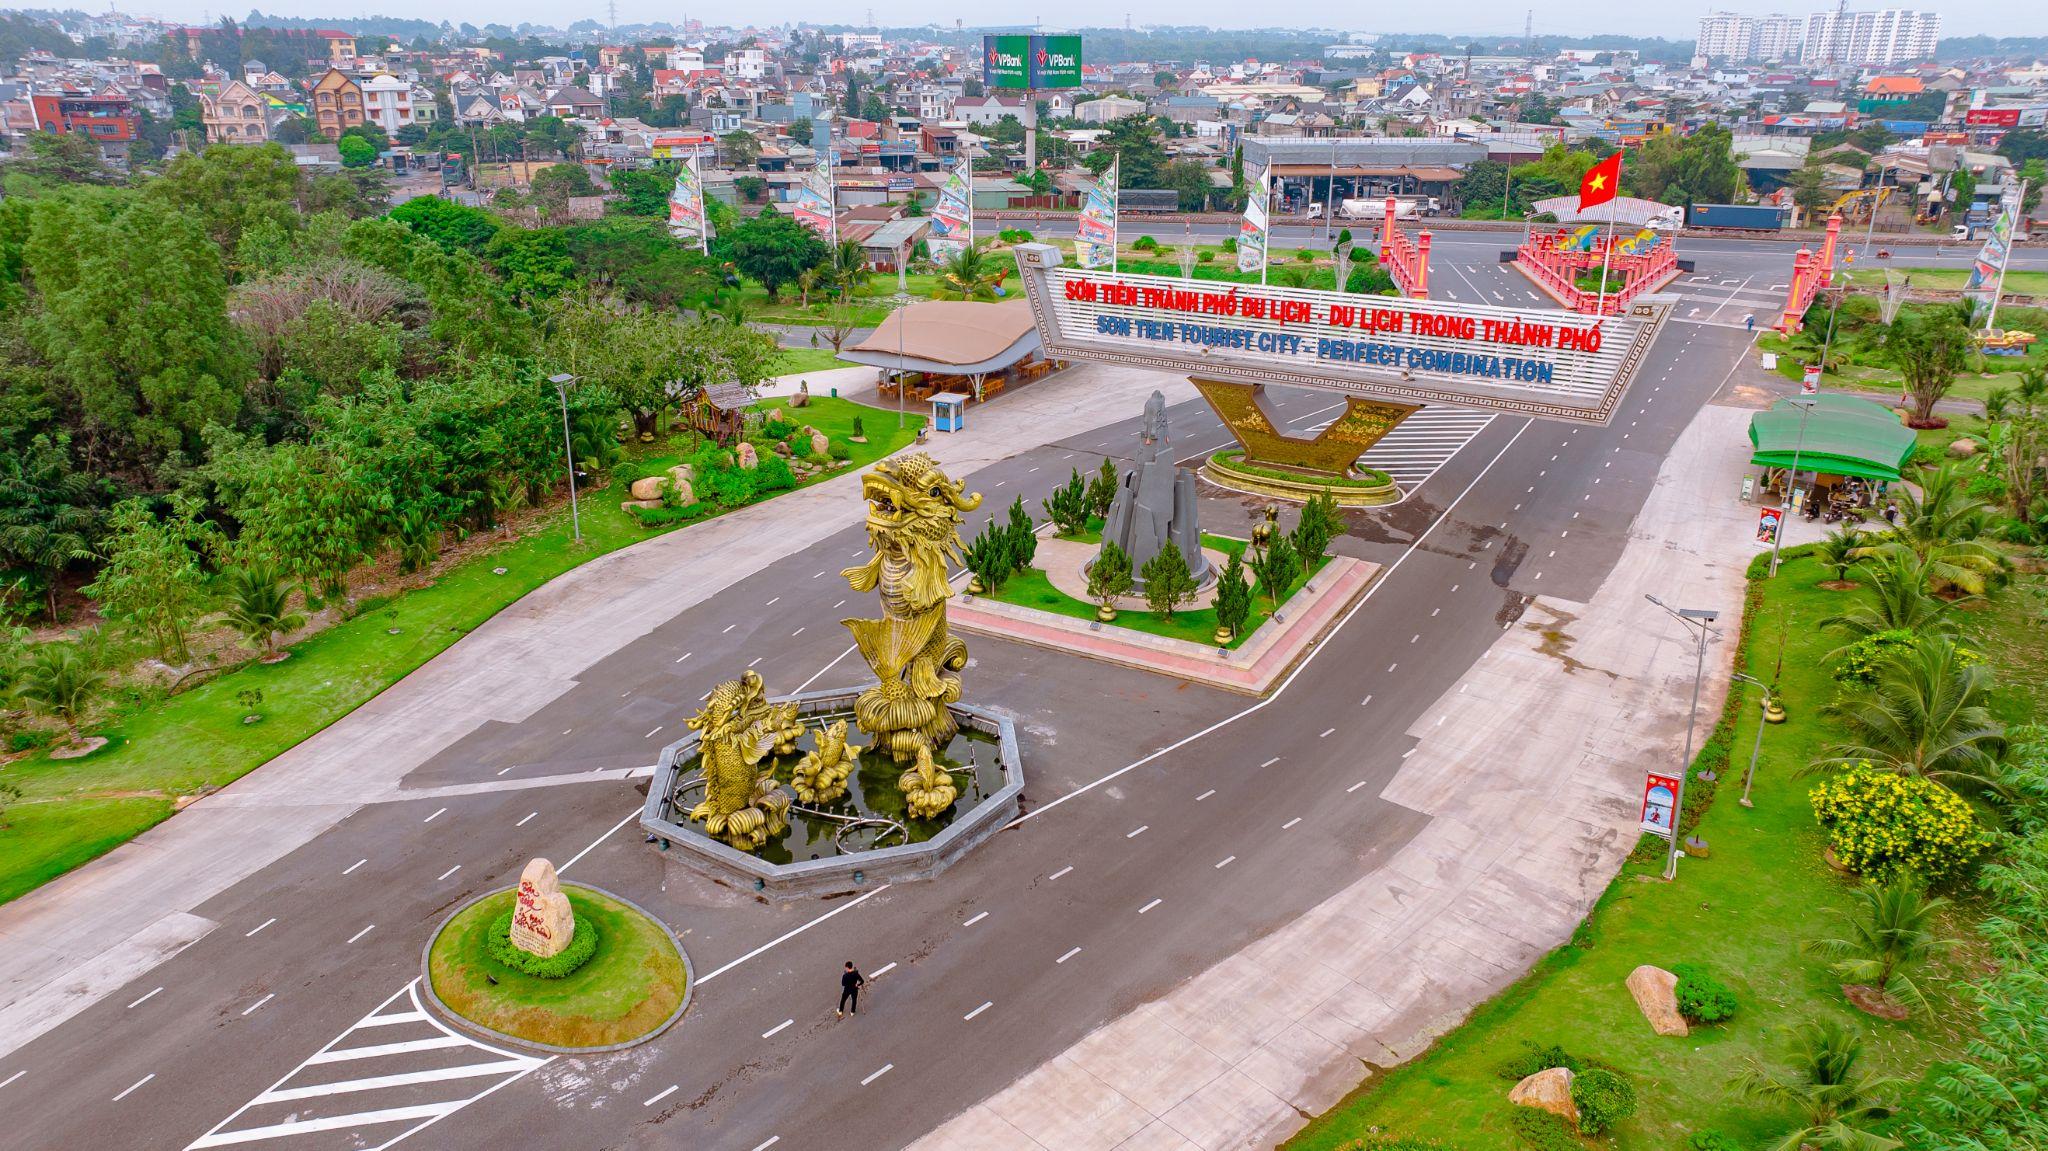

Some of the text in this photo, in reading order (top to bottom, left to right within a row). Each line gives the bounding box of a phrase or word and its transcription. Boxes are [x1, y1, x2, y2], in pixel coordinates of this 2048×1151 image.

[998, 54, 1022, 67] VPBank
[1048, 54, 1075, 67] VPBank
[1065, 277, 1097, 302] SƠN
[1101, 280, 1138, 306] TIÊN
[1141, 284, 1199, 312] THÀNH
[1203, 286, 1238, 316] PHỐ
[1242, 297, 1266, 319] DU
[1269, 299, 1311, 326] LỊCH
[1330, 305, 1355, 328] DU
[1360, 308, 1404, 335] LỊCH
[1409, 312, 1476, 340] TRONG
[1482, 316, 1553, 347] THÀNH
[1558, 319, 1604, 353] PHỐ
[1097, 315, 1131, 336] SON
[1135, 319, 1174, 341] TIEN
[1180, 323, 1254, 350] TOURIST
[1258, 332, 1301, 354] CITY
[1317, 338, 1405, 367] PERFECT
[1407, 347, 1554, 383] COMBINATION
